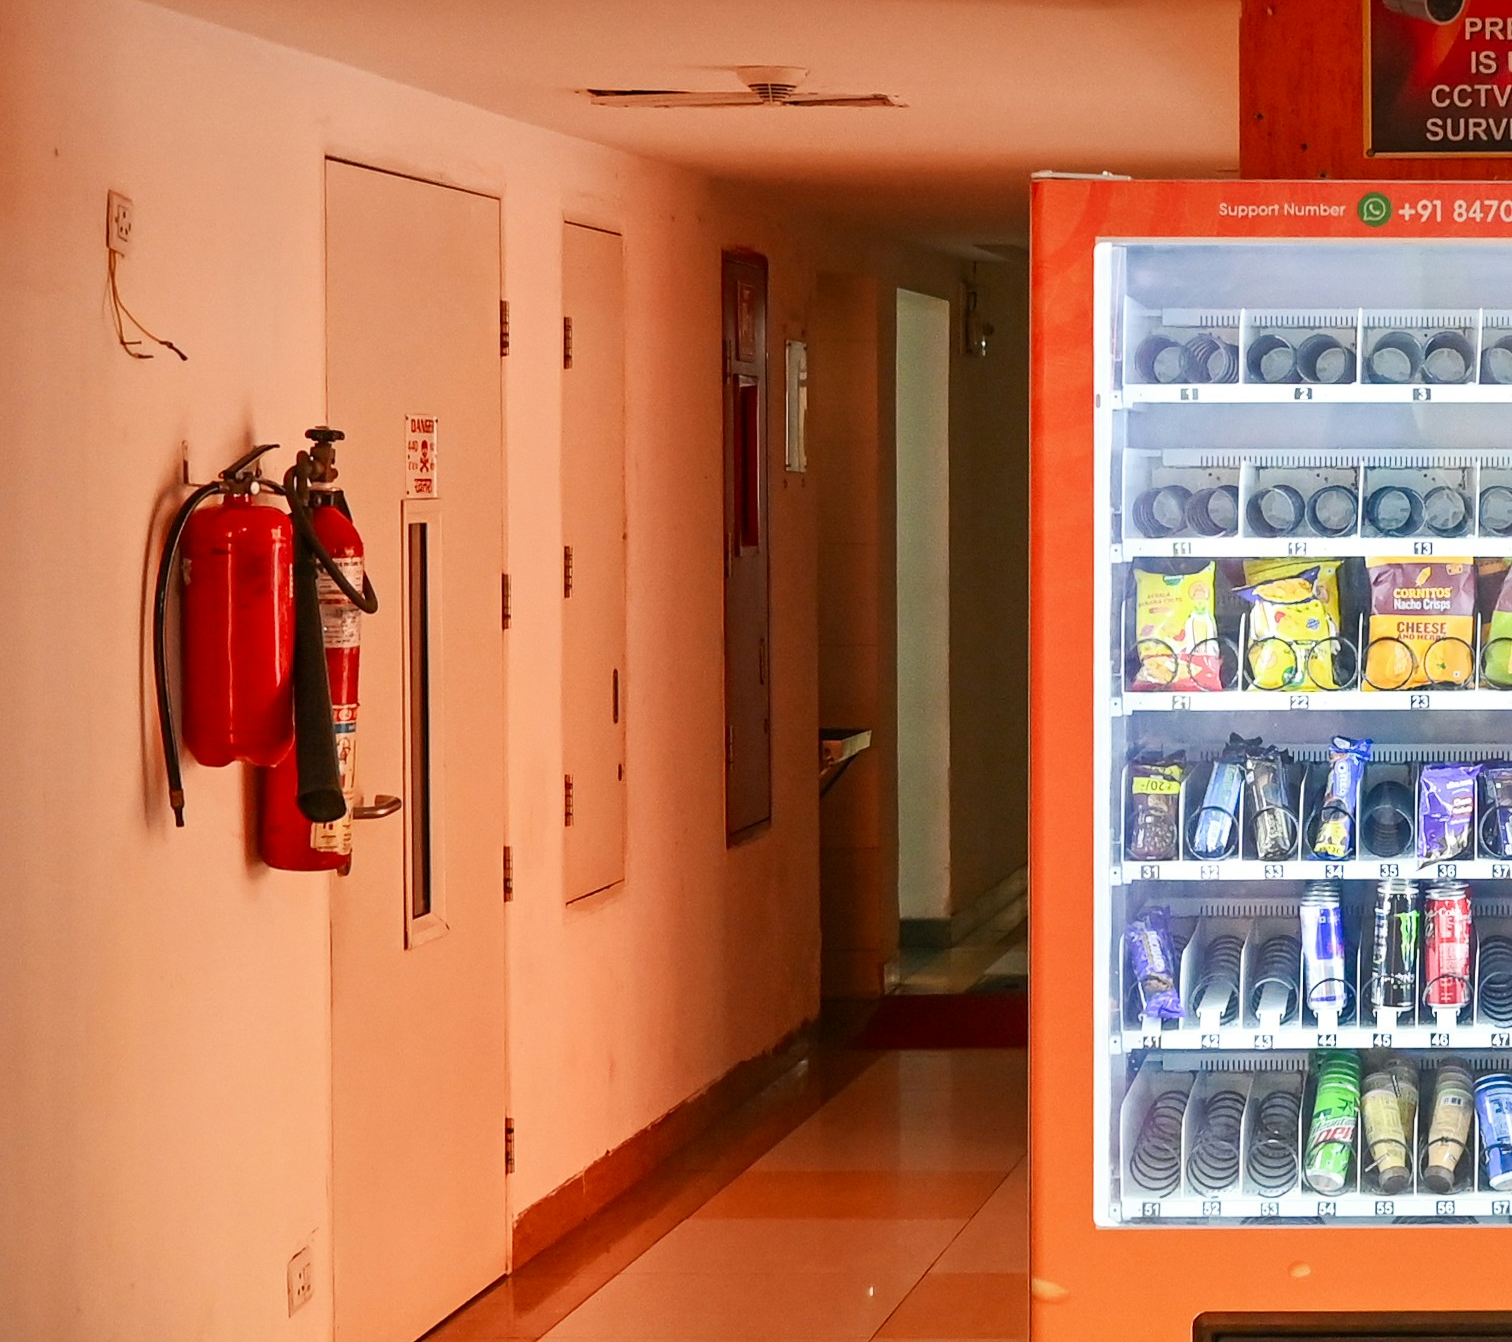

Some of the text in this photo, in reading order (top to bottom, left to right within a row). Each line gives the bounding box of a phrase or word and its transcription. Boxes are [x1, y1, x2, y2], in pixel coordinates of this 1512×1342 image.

[1471, 50, 1497, 74] IS
[1431, 84, 1512, 108] CCTV
[1219, 203, 1279, 218] Support
[1284, 202, 1346, 217] Number
[1398, 200, 1442, 223] +91
[1289, 542, 1306, 555] 12
[1414, 542, 1432, 555] 13
[1393, 587, 1451, 598] CORNITOS
[1394, 599, 1450, 611] Nacho Crisps
[1397, 622, 1447, 634] CHEESE
[1172, 694, 1190, 710] 21
[1290, 694, 1309, 710] 22
[1411, 694, 1429, 710] 23
[1141, 864, 1159, 878] 31
[1201, 864, 1219, 878] 32
[1265, 864, 1283, 878] 33
[1326, 864, 1343, 878] 34
[1380, 864, 1398, 878] 35
[1438, 864, 1456, 878] 36
[1493, 864, 1510, 878] 37
[1143, 1036, 1161, 1049] 41
[1201, 1035, 1219, 1048] 42
[1255, 1035, 1273, 1049] 43
[1318, 1034, 1336, 1048] 44
[1373, 1034, 1392, 1048] 45
[1431, 1034, 1449, 1047] 46
[1491, 1034, 1510, 1047] 47
[1143, 1202, 1160, 1216] 51
[1203, 1202, 1221, 1216] 52
[1261, 1202, 1279, 1216] 53
[1318, 1202, 1336, 1216] 54
[1375, 1201, 1394, 1215] 55
[1436, 1201, 1455, 1215] 56
[1492, 1200, 1510, 1215] 57
